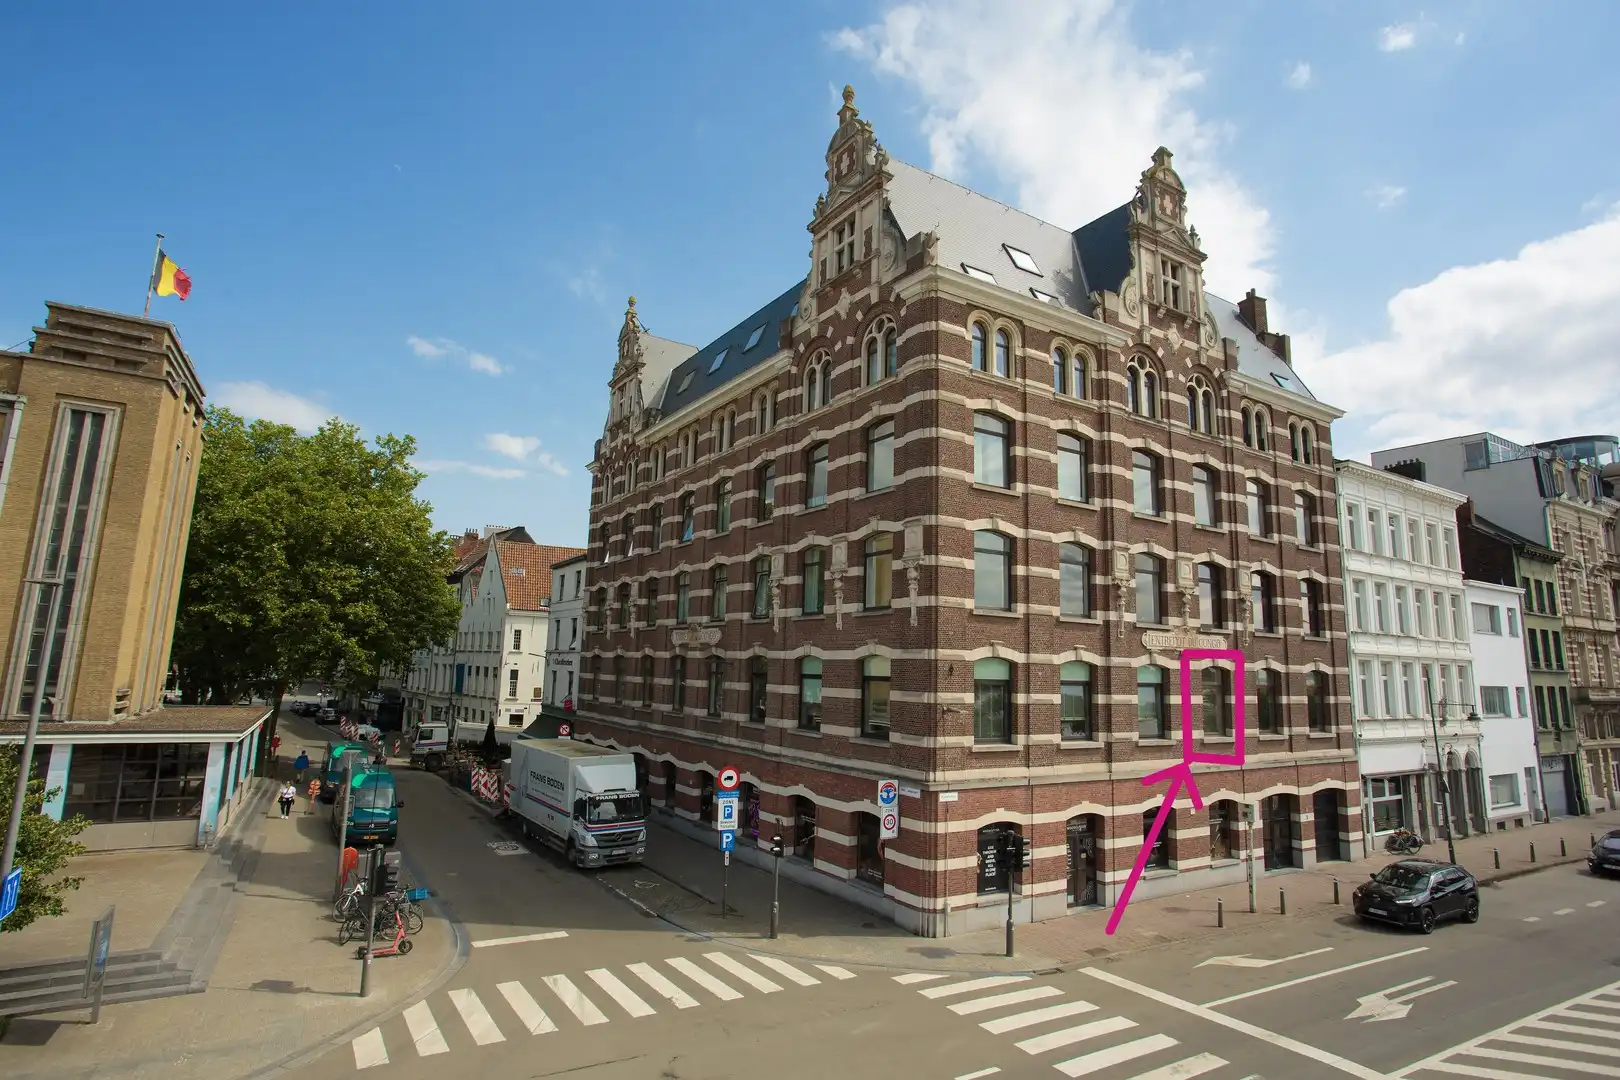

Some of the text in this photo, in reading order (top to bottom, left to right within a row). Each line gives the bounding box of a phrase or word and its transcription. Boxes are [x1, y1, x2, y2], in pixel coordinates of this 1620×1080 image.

[530, 770, 547, 784] FRANS
[724, 807, 732, 818] P
[722, 832, 732, 848] P
